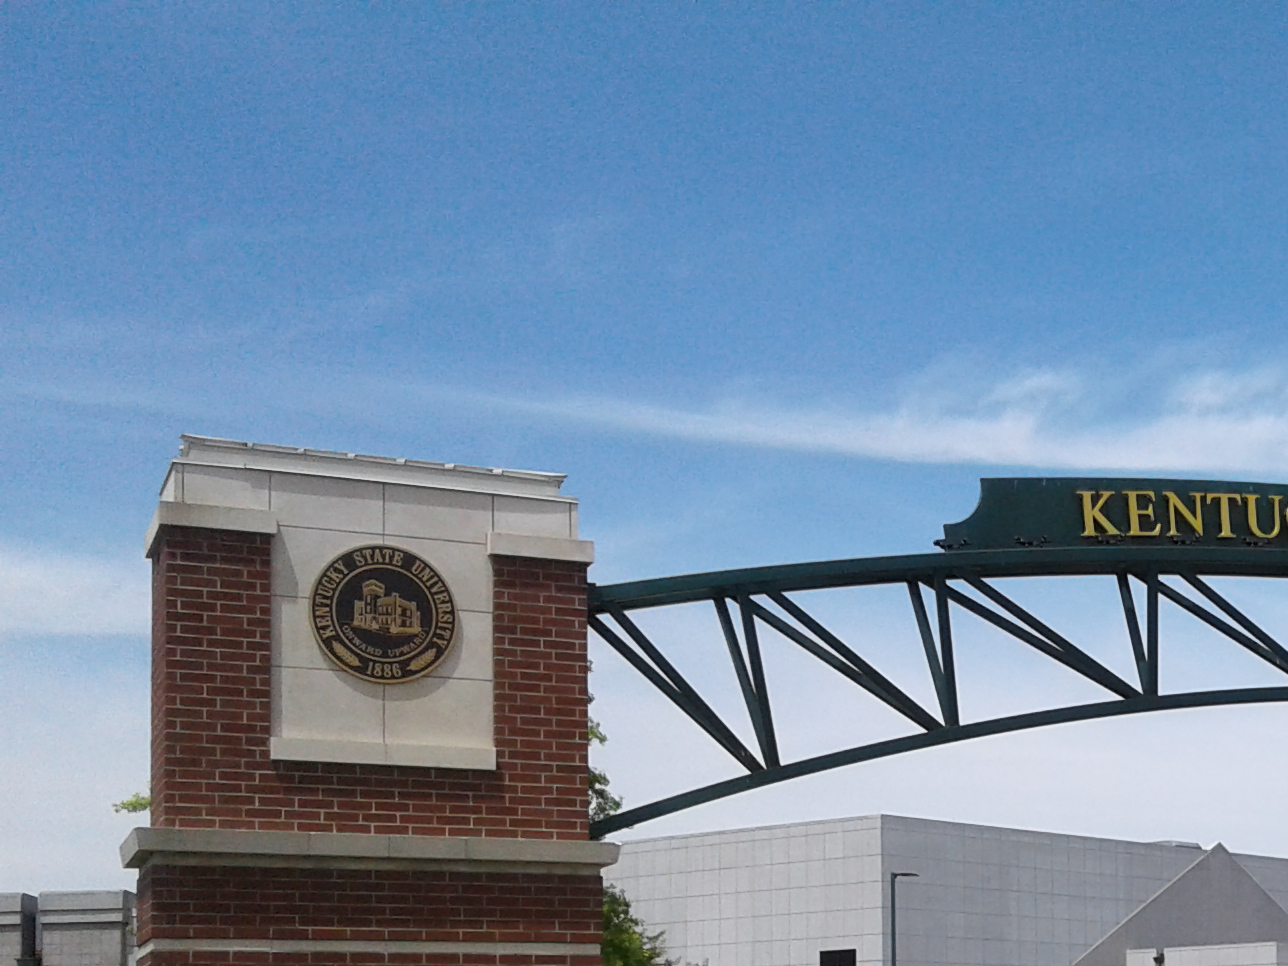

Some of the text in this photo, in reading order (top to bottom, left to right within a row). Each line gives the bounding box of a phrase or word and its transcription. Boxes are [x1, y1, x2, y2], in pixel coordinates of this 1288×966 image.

[314, 549, 454, 649] KENTUCKY STATE UNIVERSITY
[342, 625, 426, 657] ONWARD UPWARD
[366, 661, 402, 678] 1886
